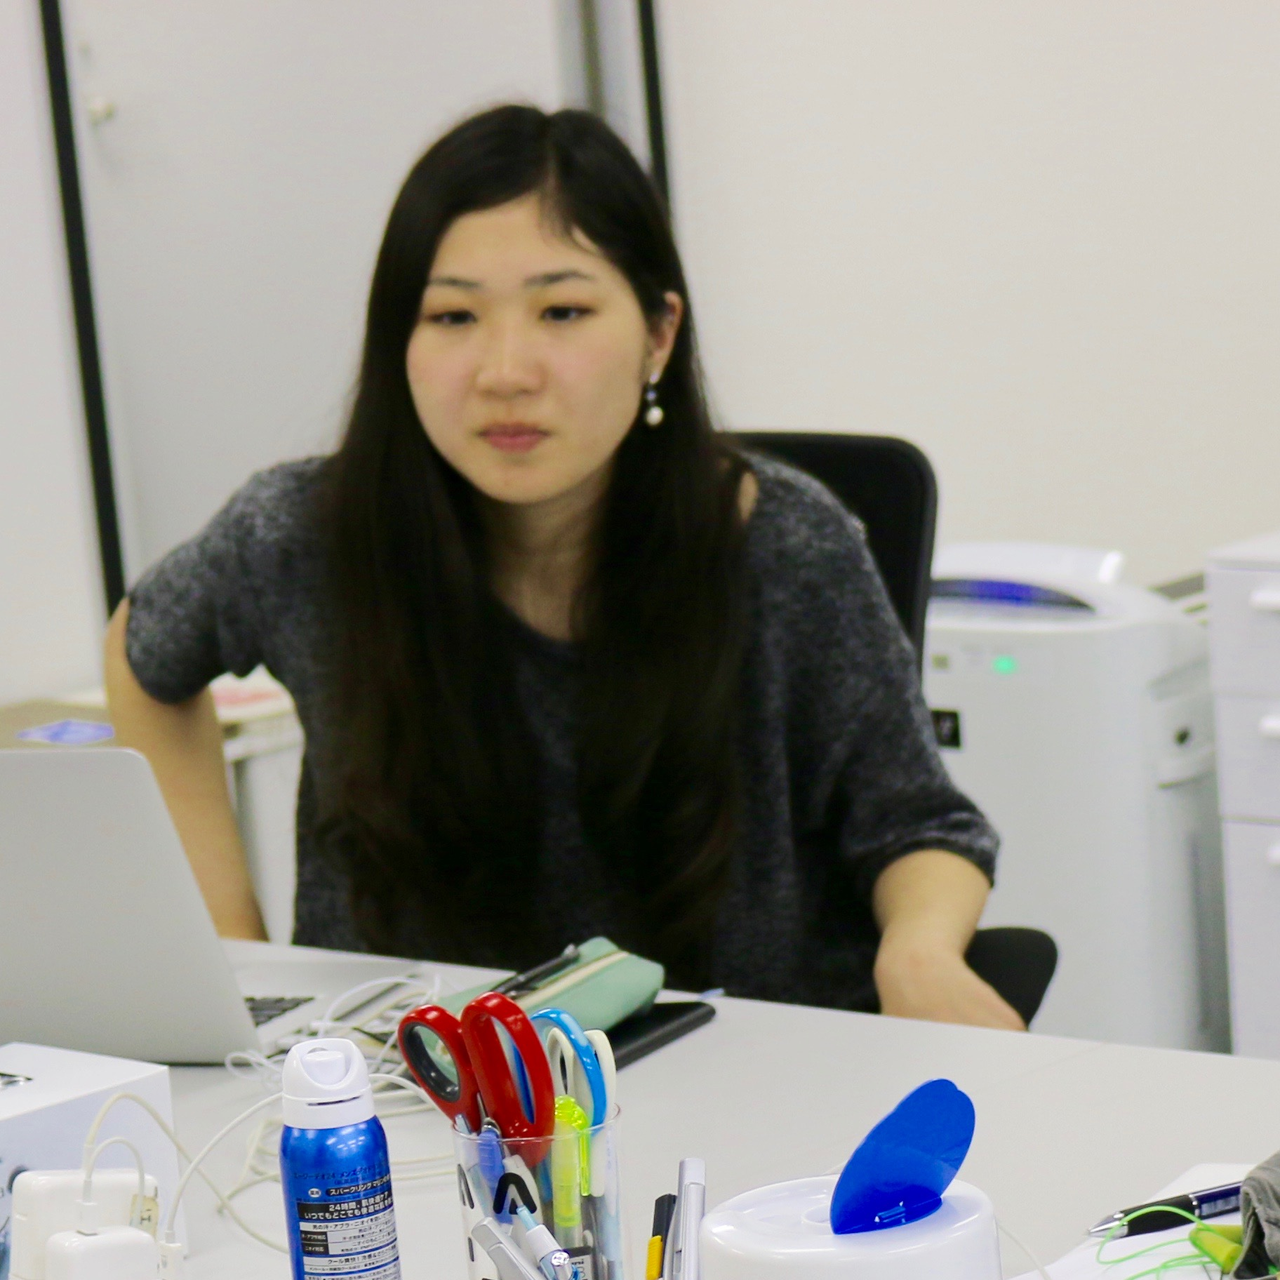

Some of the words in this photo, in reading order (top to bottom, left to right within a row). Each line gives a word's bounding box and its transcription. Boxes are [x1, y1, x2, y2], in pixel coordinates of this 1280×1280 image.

[330, 1183, 372, 1195] スパークリング
